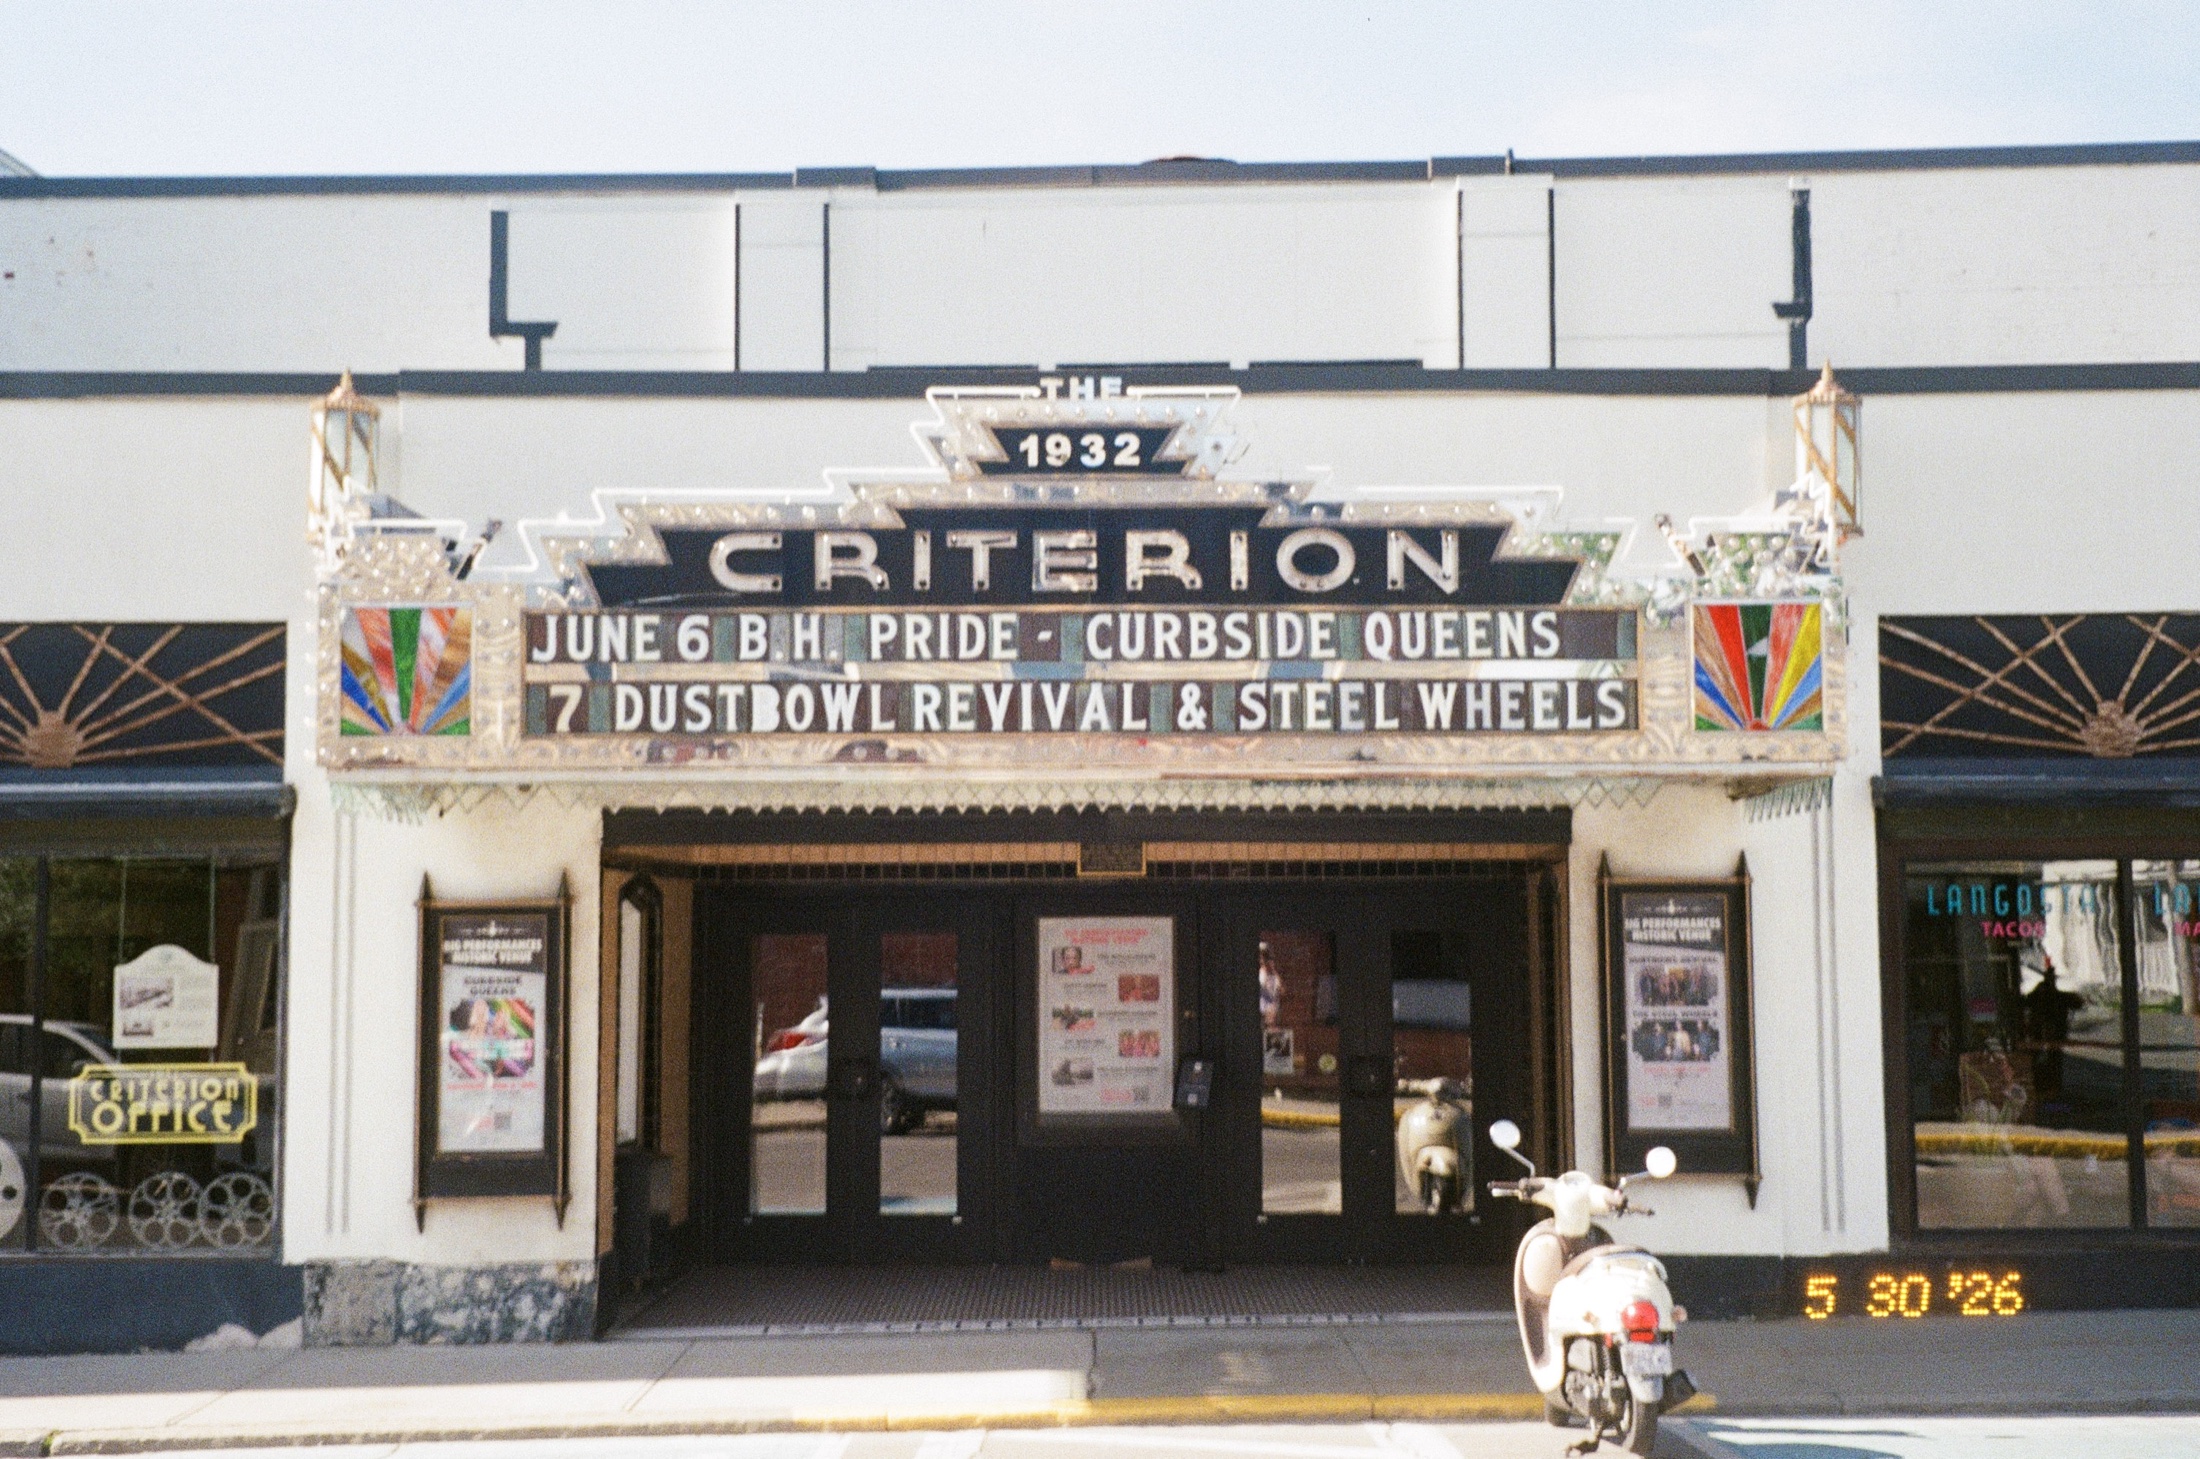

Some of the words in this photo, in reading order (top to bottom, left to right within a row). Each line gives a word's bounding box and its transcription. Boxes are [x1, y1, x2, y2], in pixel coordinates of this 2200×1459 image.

[1040, 377, 1122, 400] THE
[1019, 432, 1140, 467] 1932
[709, 529, 1459, 594] CRITERION
[531, 613, 661, 662] JUNE
[676, 614, 710, 662] 6
[738, 614, 839, 661] B.H.
[870, 613, 1018, 661] PRIDE
[1037, 630, 1052, 641] -
[1086, 612, 1336, 660] CURBSIDE
[1364, 611, 1560, 661] QUEENS
[549, 684, 583, 732] 7
[615, 684, 895, 732] DUSTBOWL
[914, 683, 1147, 731] REVIVAL
[1177, 682, 1207, 731] &
[1239, 682, 1399, 730] STEEL
[1418, 681, 1626, 729] WHEELS
[1927, 883, 2096, 916] LANGOSTA
[2153, 881, 2200, 916] LA
[1981, 921, 2046, 938] TACOS
[91, 1078, 238, 1100] CRITERION
[91, 1101, 232, 1133] OFFICE
